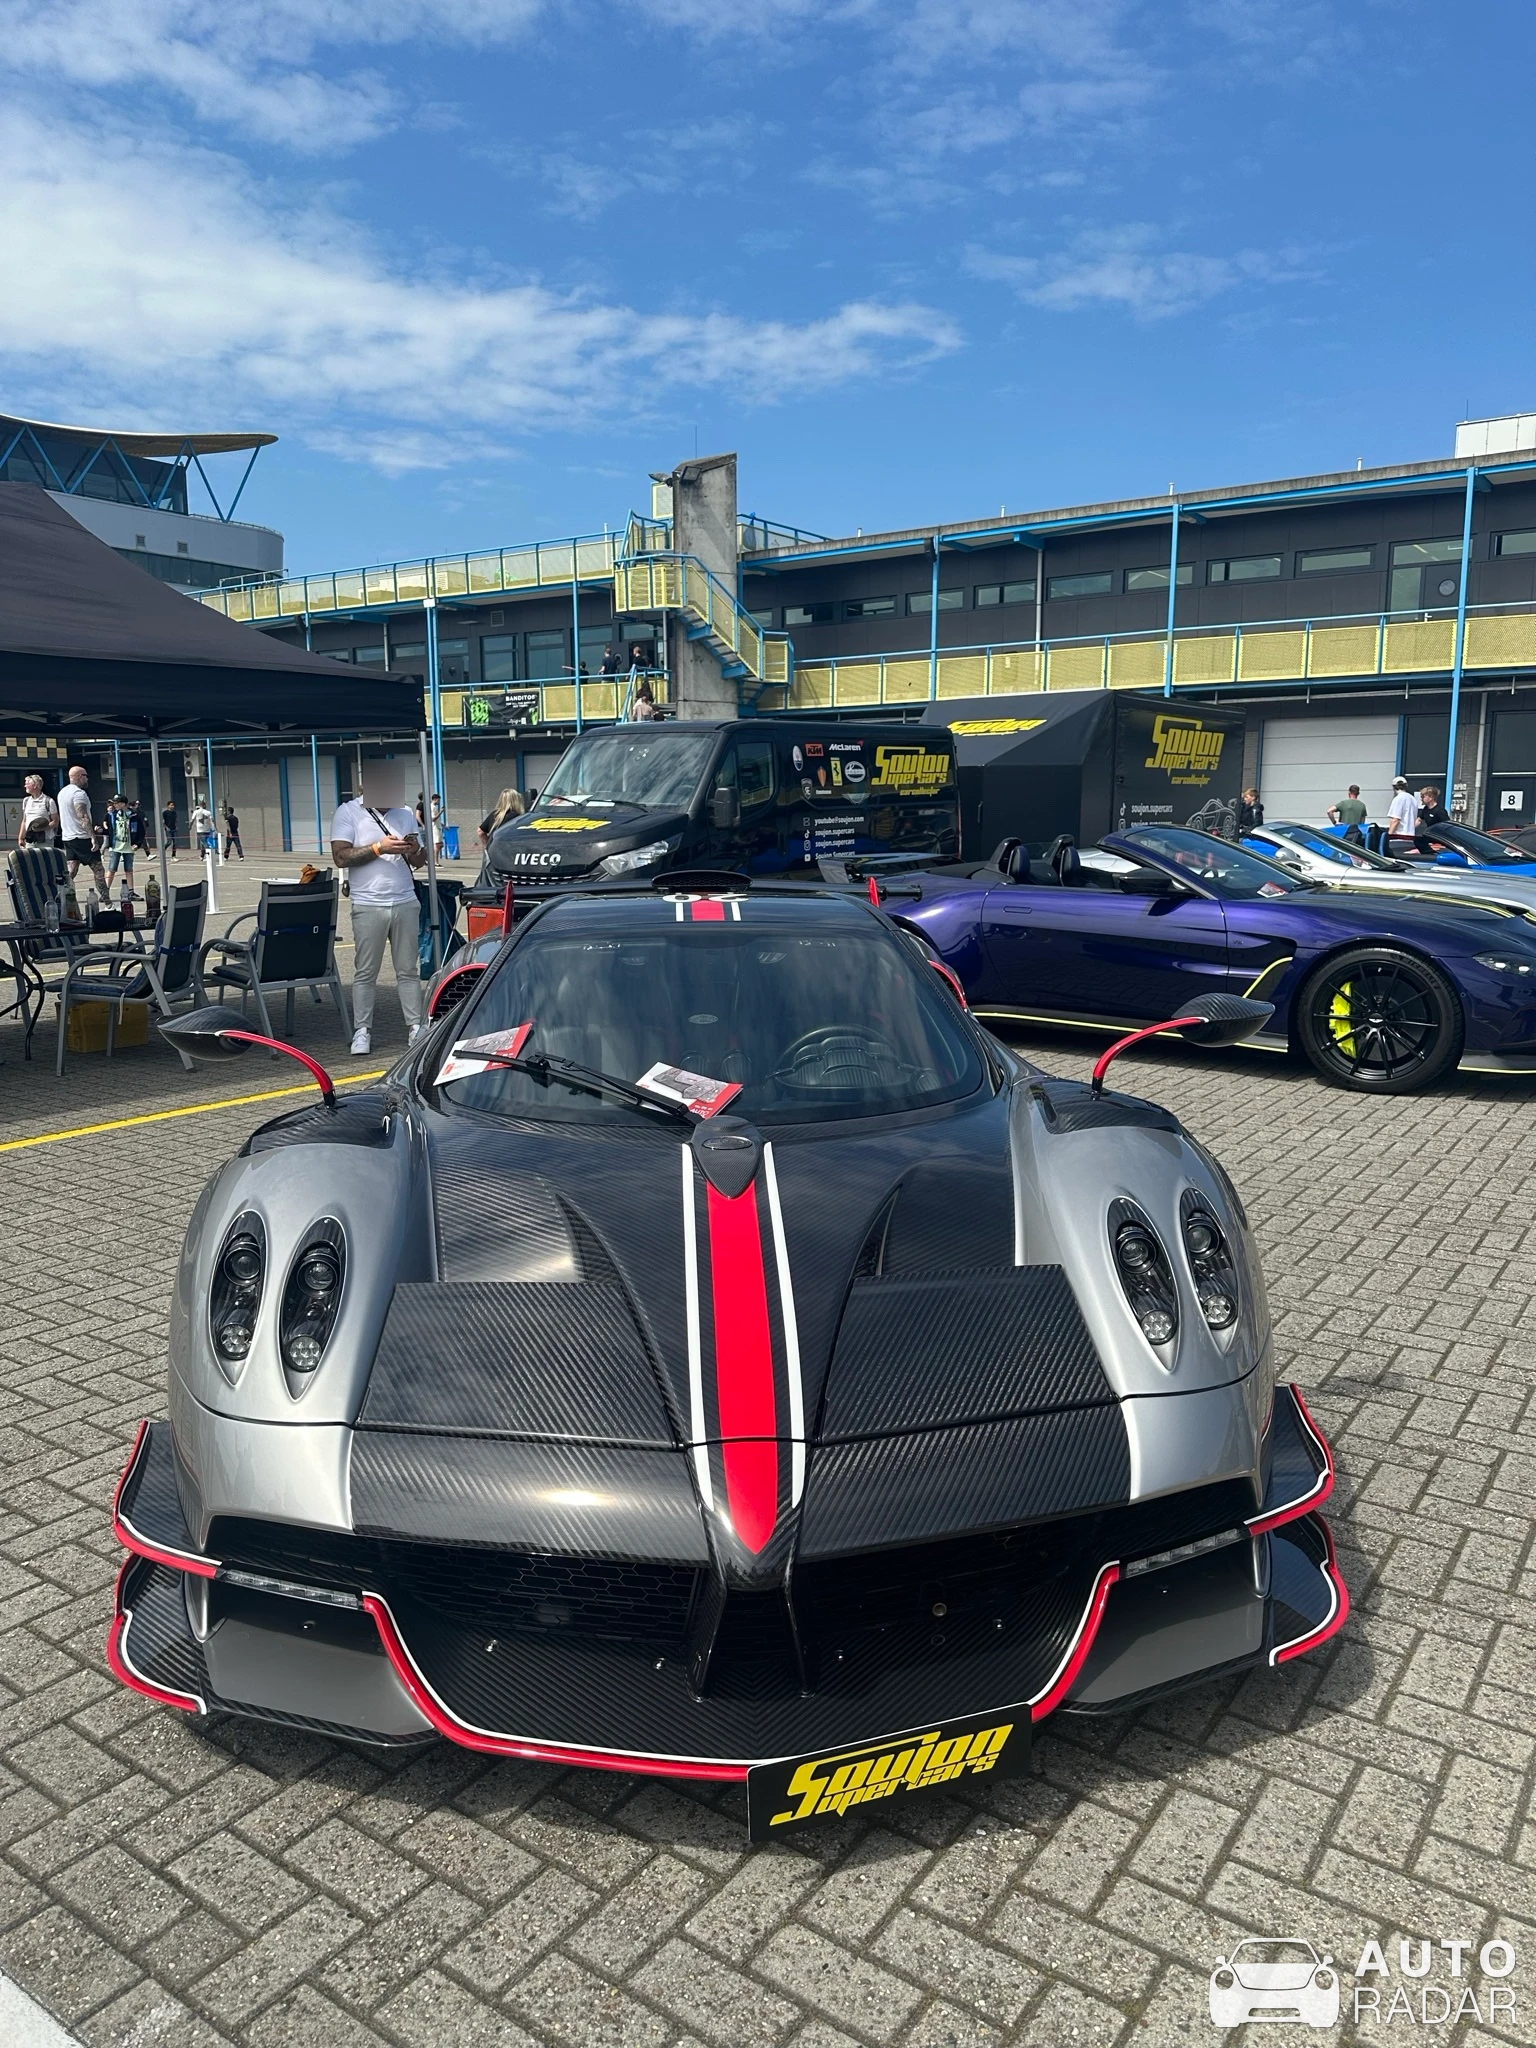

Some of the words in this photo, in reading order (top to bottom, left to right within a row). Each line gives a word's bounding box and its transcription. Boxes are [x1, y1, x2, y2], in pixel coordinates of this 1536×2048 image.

[829, 743, 861, 751] McLaren
[1144, 715, 1225, 768] Soujon
[807, 746, 822, 755] KTM
[871, 746, 950, 785] Soujon
[1507, 794, 1516, 806] 8
[514, 853, 561, 866] IVECO
[769, 1723, 1014, 1826] Soujon
